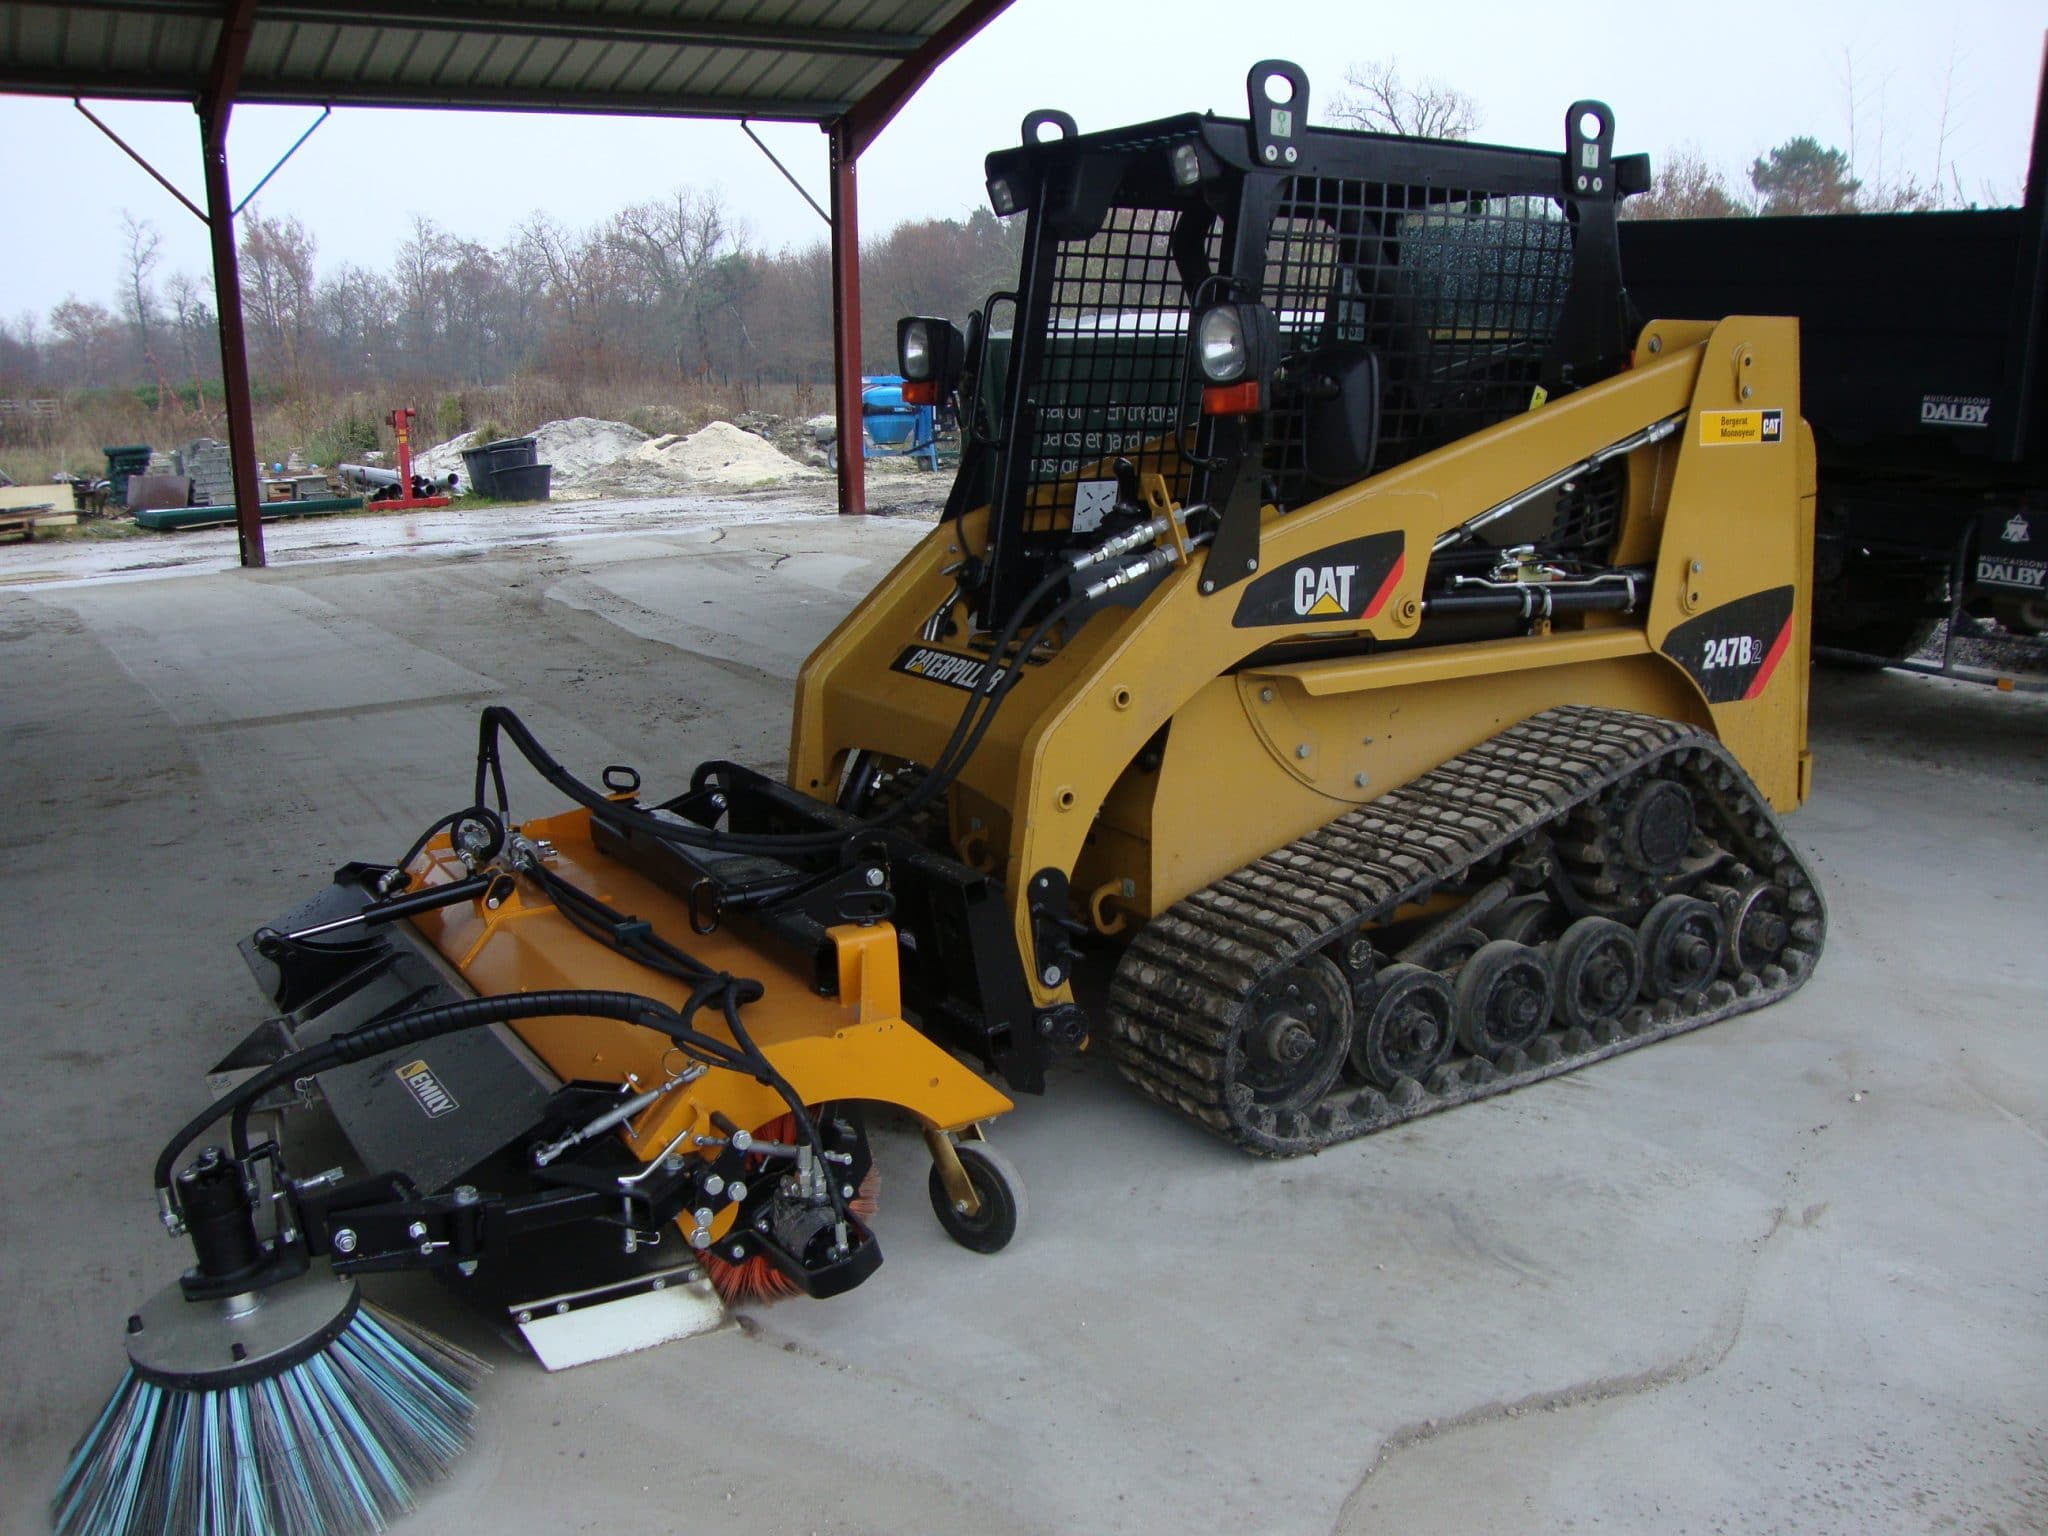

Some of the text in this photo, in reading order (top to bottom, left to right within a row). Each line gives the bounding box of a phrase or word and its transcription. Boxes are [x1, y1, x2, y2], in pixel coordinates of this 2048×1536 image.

[1720, 416, 1748, 427] Bergerat
[1921, 402, 1990, 423] DALBY
[1720, 428, 1755, 438] Monnoyeur
[1763, 418, 1780, 434] CAT
[1976, 562, 2047, 585] DALBY
[1294, 565, 1356, 616] CAT
[903, 648, 1007, 693] CATERPILLR
[409, 1071, 454, 1114] EMILY
